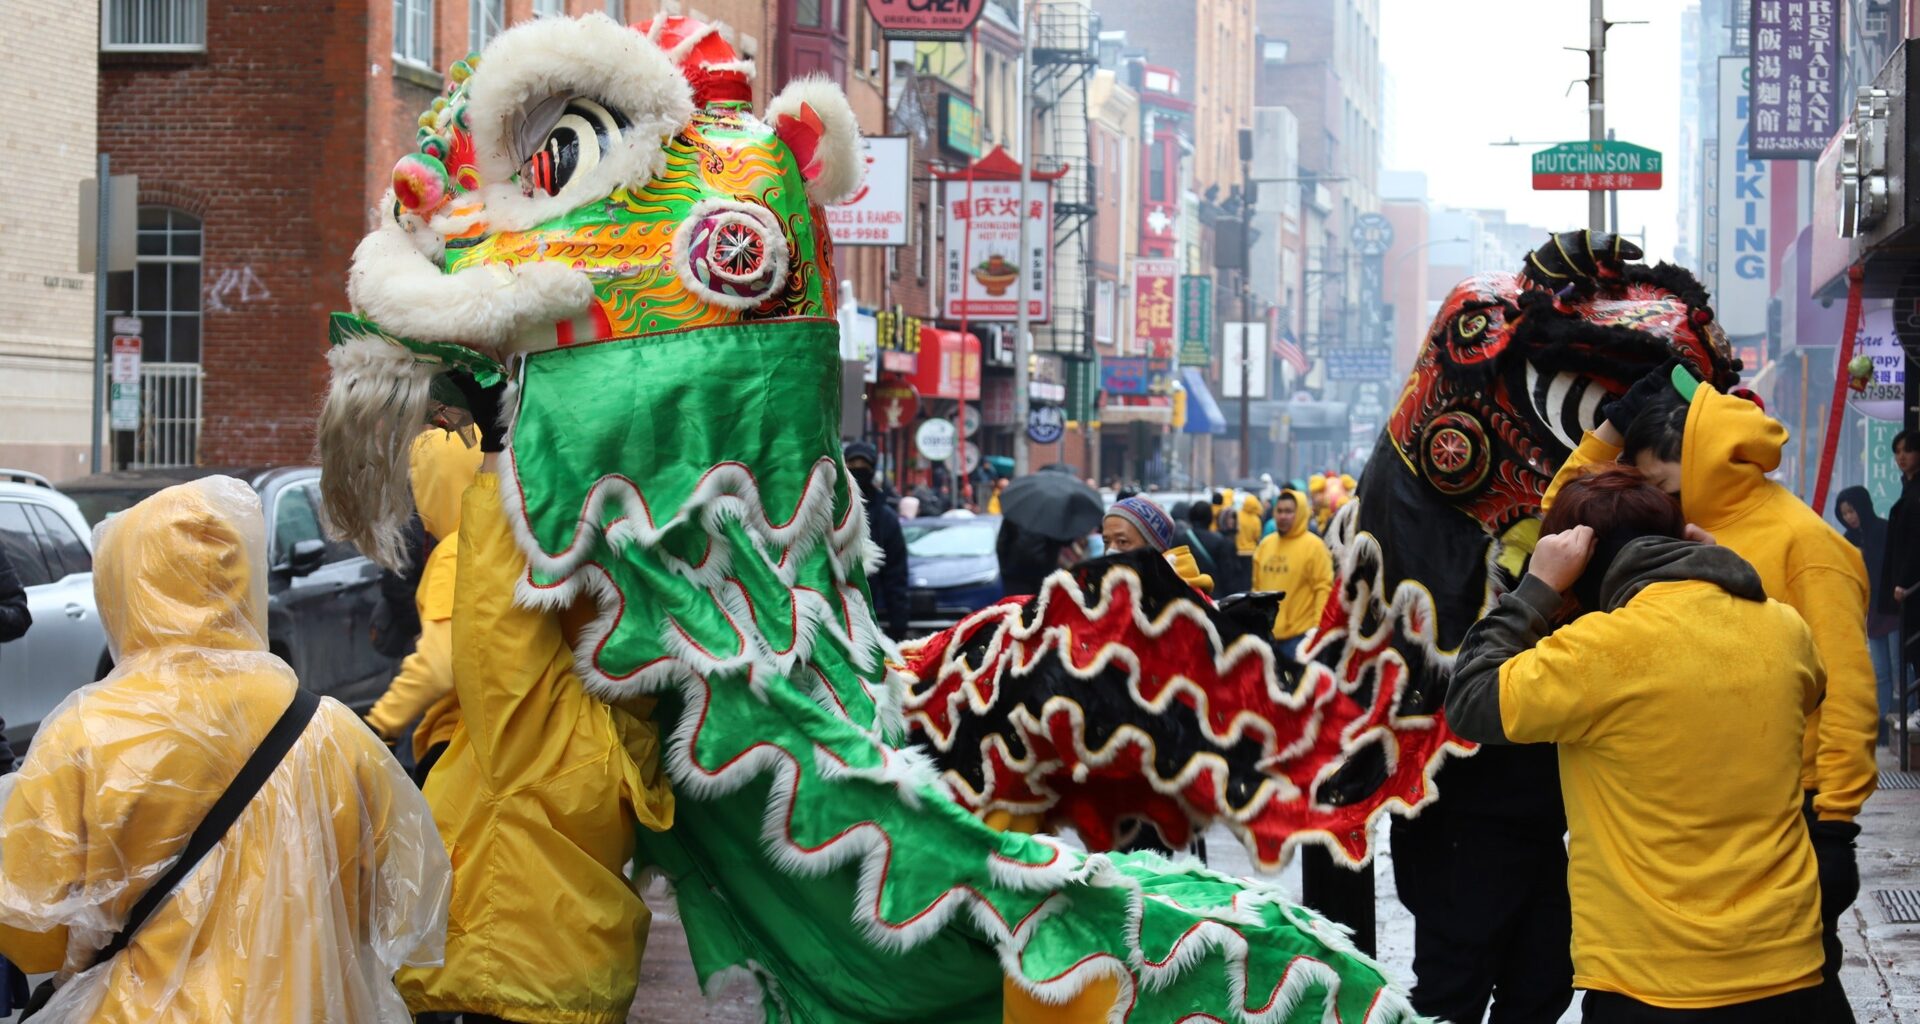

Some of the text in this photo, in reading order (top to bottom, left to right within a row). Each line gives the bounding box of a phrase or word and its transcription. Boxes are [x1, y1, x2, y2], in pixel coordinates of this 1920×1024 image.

[884, 14, 963, 25] ORIENTAL DINING
[1807, 1, 1832, 133] RESTAURANT
[1573, 144, 1589, 152] 100
[1535, 153, 1660, 172] HUTCHINSON ST
[867, 211, 902, 224] RAMEN
[832, 228, 888, 240] 48-9988
[979, 232, 996, 241] HOT
